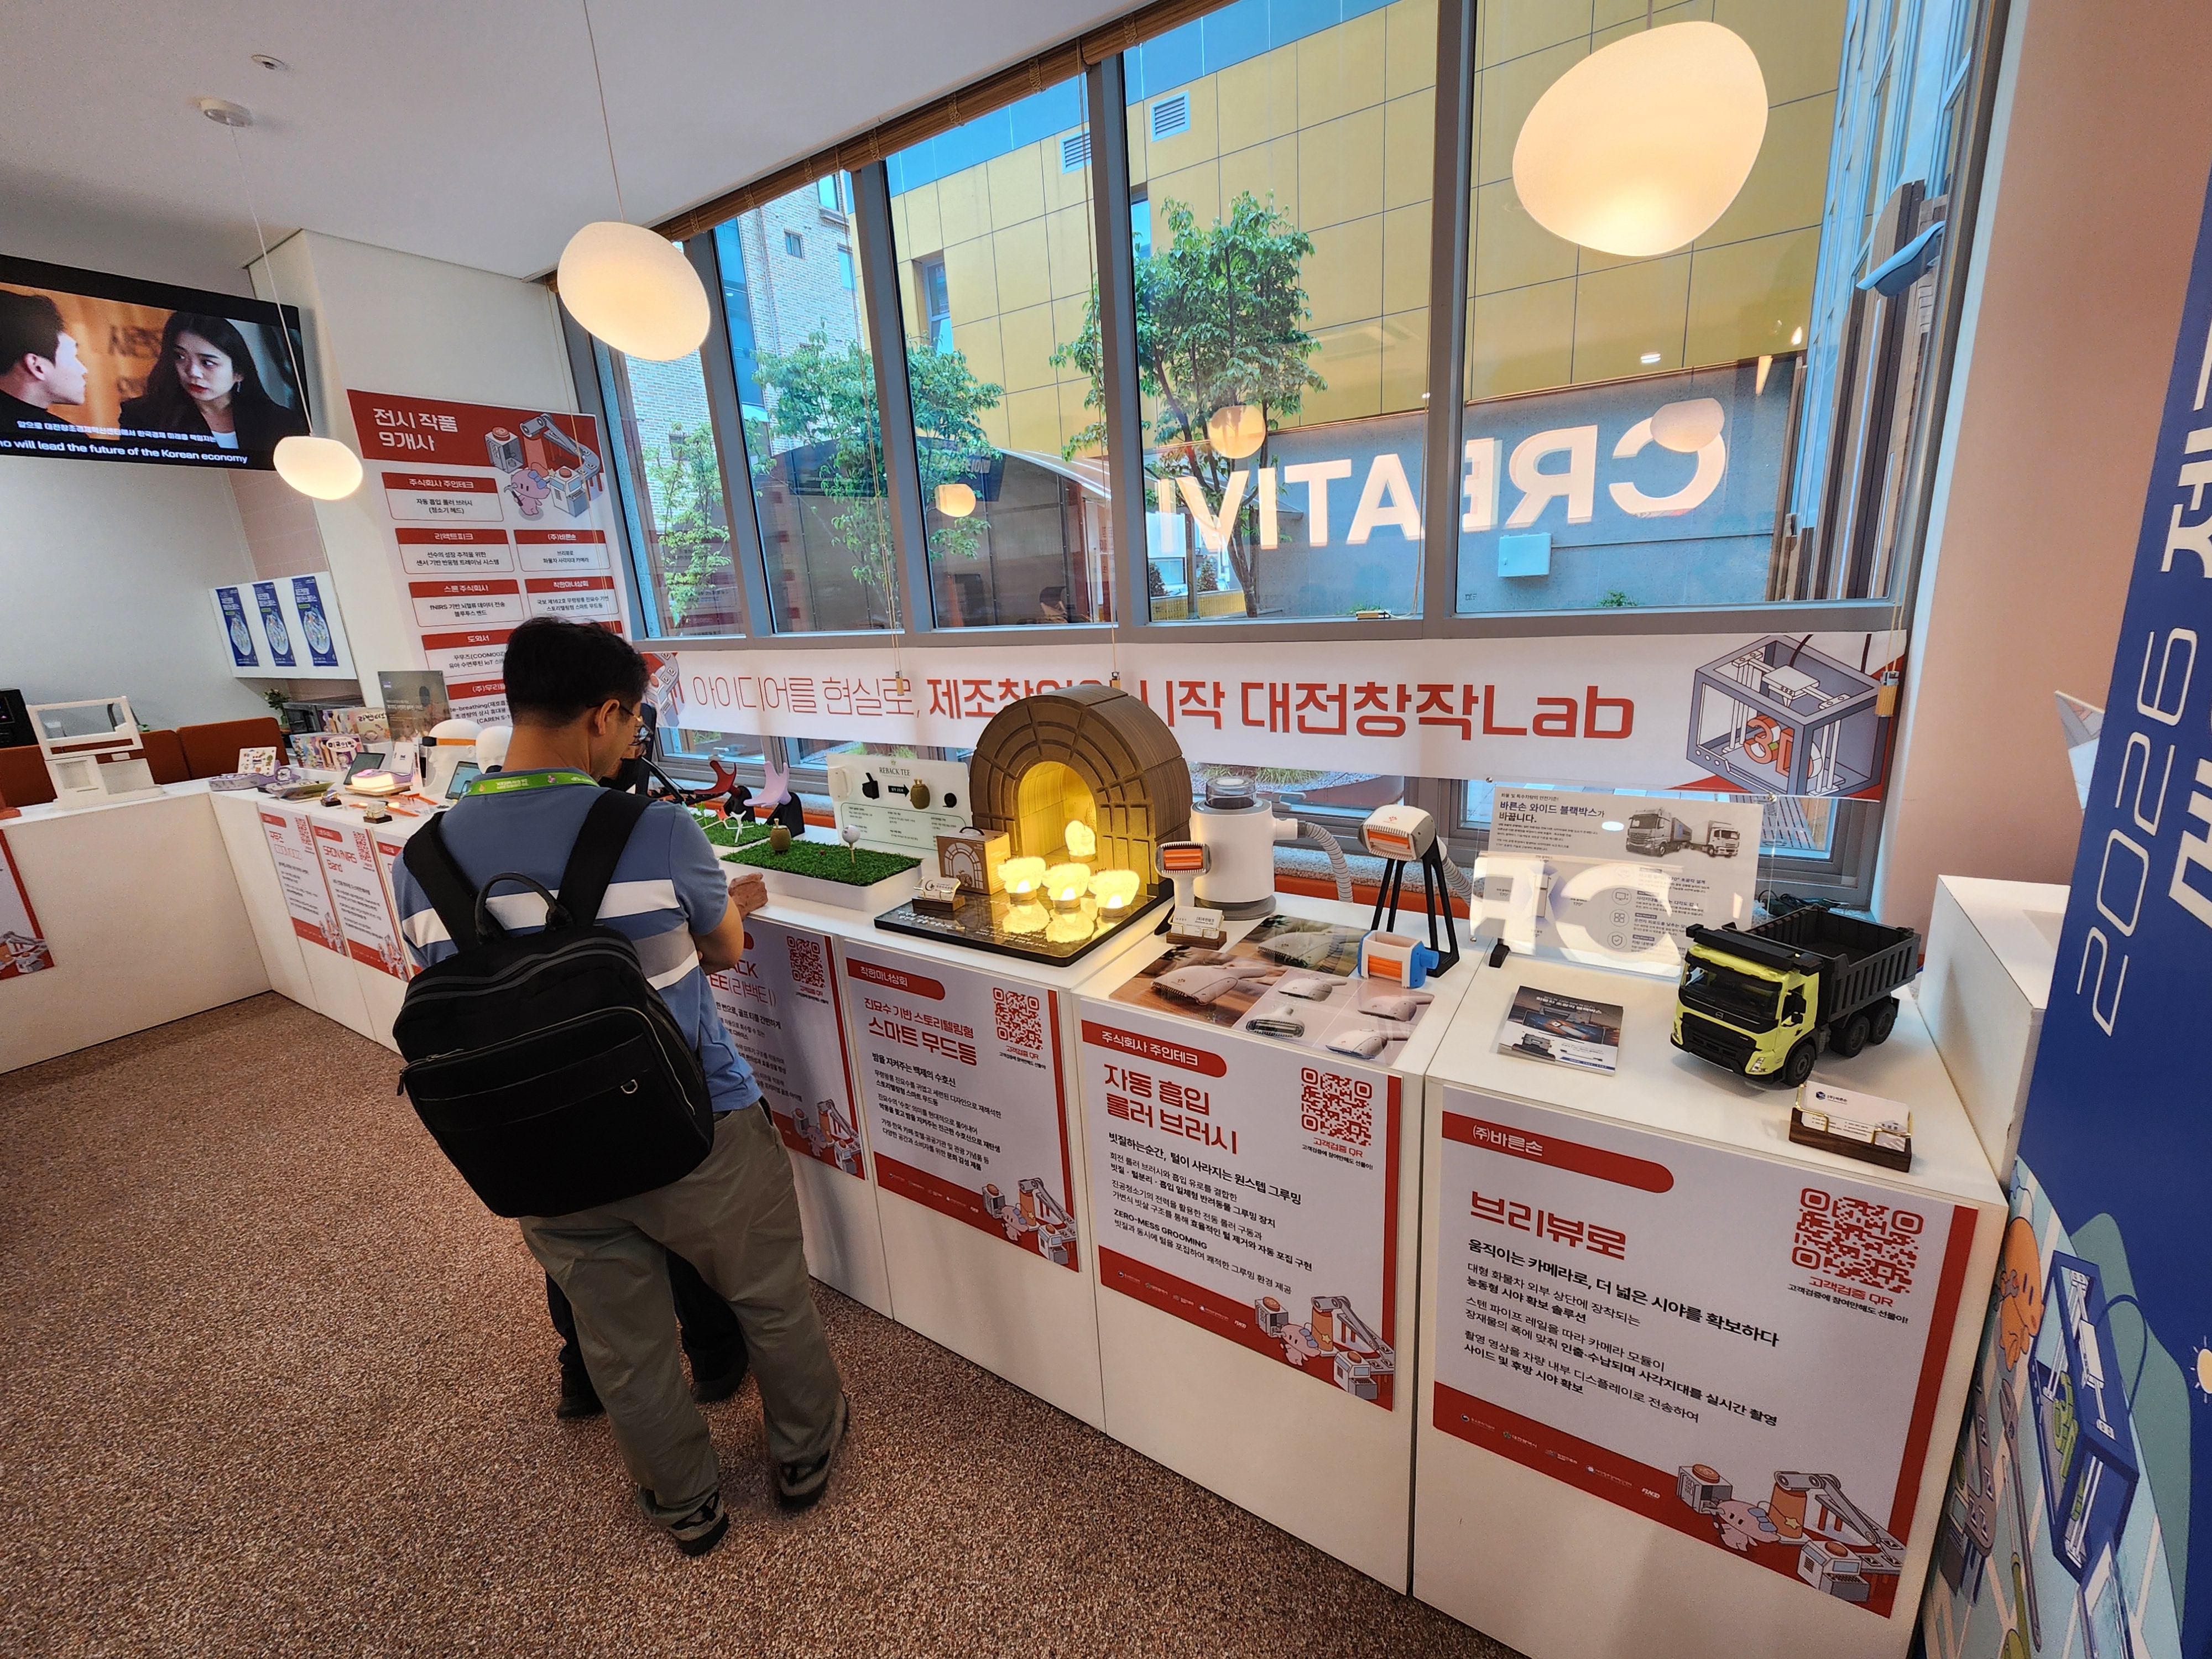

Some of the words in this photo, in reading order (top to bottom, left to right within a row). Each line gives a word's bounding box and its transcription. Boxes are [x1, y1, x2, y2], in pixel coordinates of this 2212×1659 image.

[373, 408, 416, 429] 전시
[418, 413, 458, 432] 작품
[38, 440, 65, 451] lead
[67, 443, 87, 453] the
[89, 444, 125, 455] future
[127, 447, 139, 456] of
[141, 448, 159, 457] the
[161, 450, 200, 460] Korean
[201, 453, 248, 464] economy
[378, 431, 435, 452] 9개사
[409, 478, 442, 487] 주식회사
[443, 481, 474, 489] 주인테크
[693, 675, 818, 714] 아이디어를
[822, 675, 920, 718] 현실로,
[1240, 681, 1635, 742] 대전창작Lab
[879, 766, 900, 776] REBACK
[1499, 811, 1537, 823] 바꿉니다.
[1500, 801, 1527, 812] 바른손
[1529, 803, 1557, 814] 와이드
[1560, 805, 1605, 818] 블랙박스가
[2075, 627, 2198, 1037] 2026
[860, 966, 909, 988] 착한마녀상회
[864, 997, 892, 1015] 진묘수
[893, 1005, 912, 1021] 기반
[914, 1012, 974, 1039] 스토리텔링형
[868, 1016, 919, 1048] 스마트
[921, 1030, 978, 1067] 무드등
[1101, 1030, 1148, 1053] 주식회사
[1149, 1042, 1199, 1067] 주인테크
[872, 1052, 885, 1065] 밤을
[885, 1056, 912, 1074] 지켜주는
[935, 1072, 956, 1088] 수호신
[1103, 1063, 1153, 1099] 자동
[1158, 1079, 1210, 1117] 흡입
[1107, 1092, 1154, 1129] 롤러
[1159, 1108, 1238, 1156] 브러시
[1348, 1147, 1364, 1159] QR
[1141, 1162, 1171, 1180] 브러시와
[1213, 1187, 1238, 1203] 결합한
[1170, 1151, 1190, 1169] 털이
[1192, 1160, 1233, 1182] 사라지는
[1234, 1173, 1267, 1194] 원스텝
[1268, 1185, 1302, 1206] 그루밍
[1113, 1208, 1160, 1232] ZERO-MESS
[1161, 1226, 1208, 1250] GROOMING
[1233, 1205, 1258, 1221] 그루밍
[1259, 1214, 1276, 1228] 장치
[1470, 1191, 1627, 1261] 브리뷰로
[1466, 1276, 1500, 1295] 능동형
[1501, 1288, 1524, 1303] 시야
[1526, 1295, 1550, 1311] 확보
[1551, 1304, 1587, 1324] 솔루션
[1467, 1262, 1489, 1273] 대형
[1491, 1270, 1526, 1290] 화물차
[1527, 1281, 1551, 1297] 외부
[1553, 1290, 1588, 1311] 상단에
[1591, 1301, 1641, 1327] 장착되는
[1468, 1238, 1525, 1267] 움직이는
[1527, 1258, 1593, 1290] 카메라로,
[1595, 1278, 1612, 1295] 더
[1615, 1284, 1648, 1306] 넓은
[1651, 1296, 1703, 1323] 시야를
[1705, 1312, 1780, 1348] 확보하다
[1787, 1283, 1831, 1302] 고객검증에
[1832, 1296, 1877, 1315] 참여만해도
[1878, 1309, 1909, 1324] 선물이!
[1808, 1276, 1866, 1301] 고객검증
[1868, 1293, 1894, 1308] QR
[1465, 1296, 1488, 1311] 스텐
[1490, 1303, 1522, 1323] 파이프
[1525, 1316, 1559, 1335] 레일을
[1562, 1328, 1587, 1344] 따라
[1588, 1337, 1625, 1358] 카메라
[1626, 1351, 1665, 1373] 모듈이
[1464, 1343, 1496, 1362] 사이드
[1498, 1355, 1509, 1368] 및
[1511, 1360, 1533, 1376] 후방
[1535, 1369, 1559, 1386] 시야
[1559, 1379, 1584, 1395] 확보
[1464, 1329, 1486, 1345] 촬영
[1488, 1339, 1521, 1358] 영상을
[1522, 1351, 1546, 1366] 차량
[1548, 1359, 1571, 1376] 내부
[1573, 1369, 1646, 1404] 디스플레이로
[1648, 1396, 1700, 1424] 전송하여
[1510, 1324, 1533, 1340] 폭에
[1536, 1333, 1558, 1349] 맞춰
[1638, 1369, 1704, 1401] 사각지대를
[1705, 1392, 1748, 1417] 실시간
[1749, 1408, 1778, 1427] 촬영
